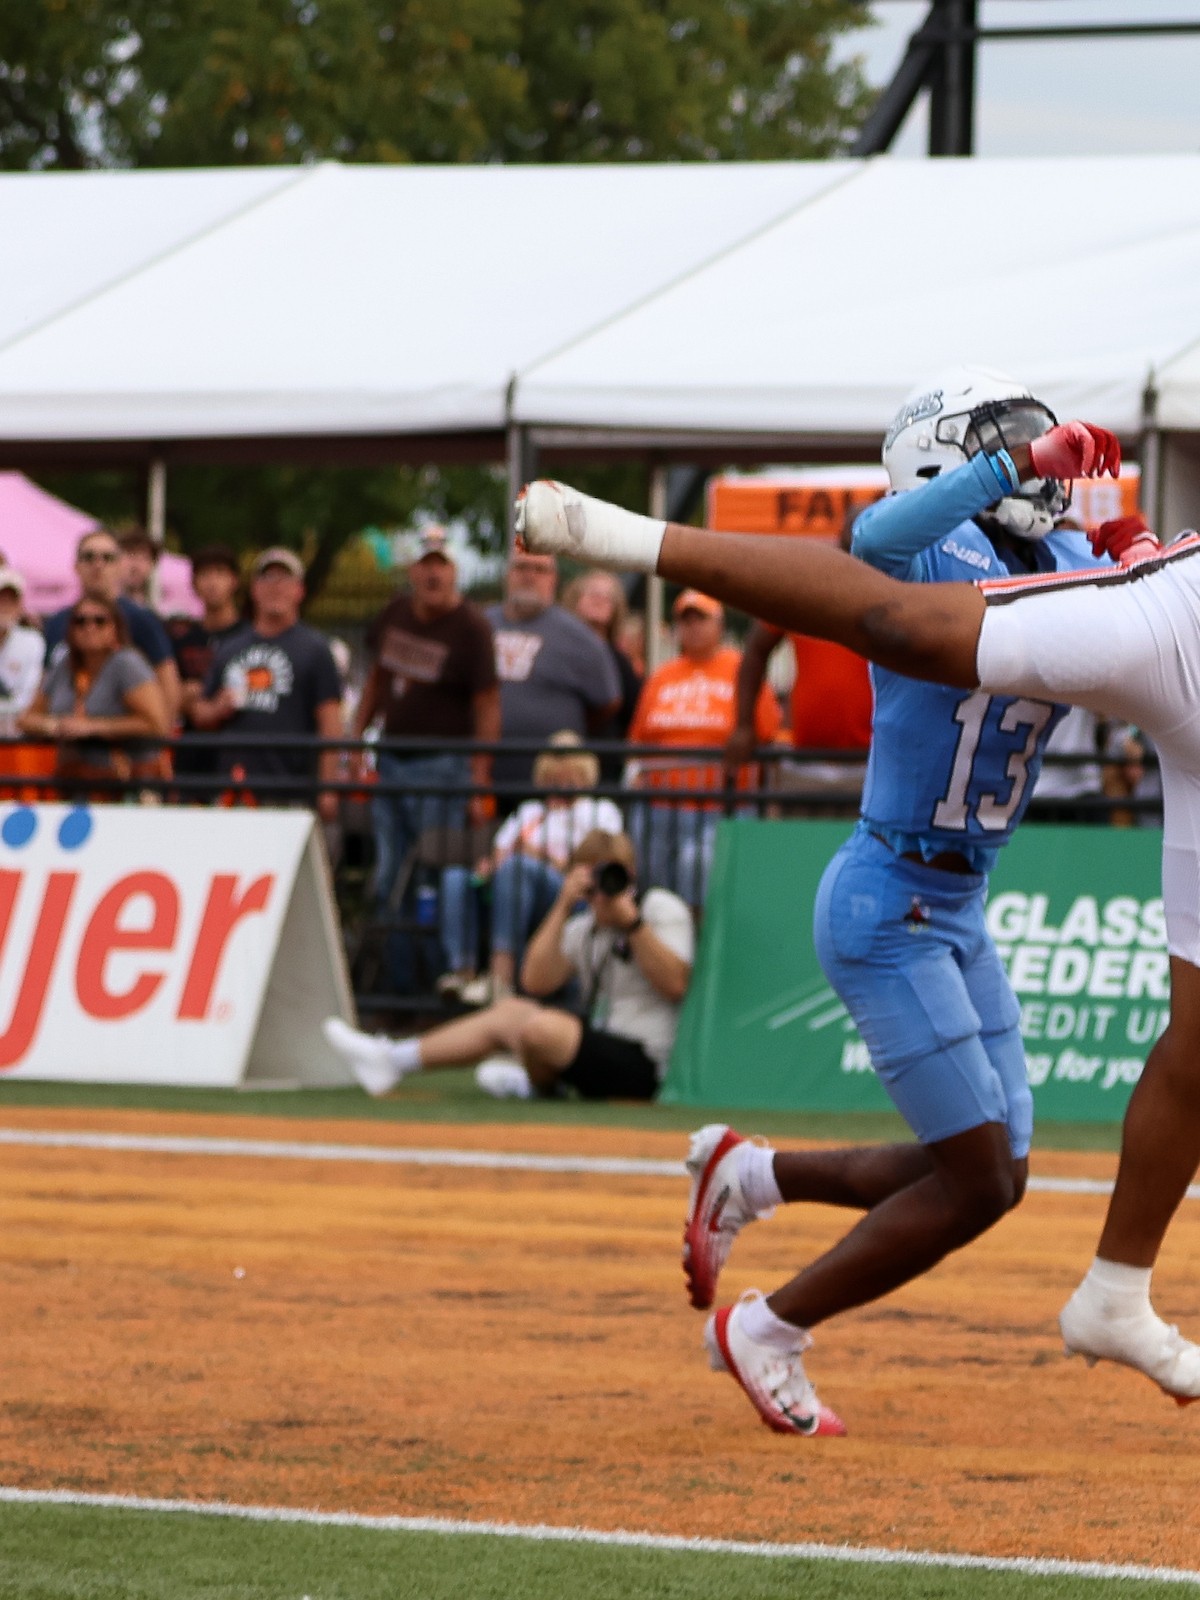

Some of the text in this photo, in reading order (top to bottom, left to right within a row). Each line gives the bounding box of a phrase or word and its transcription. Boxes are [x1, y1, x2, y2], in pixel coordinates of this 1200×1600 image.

[932, 688, 1053, 831] 13
[986, 891, 1169, 946] GLASS
[998, 943, 1171, 1000] EDER
[1020, 1000, 1117, 1042] EDIT
[1054, 1048, 1101, 1083] for
[1102, 1058, 1148, 1090] yo
